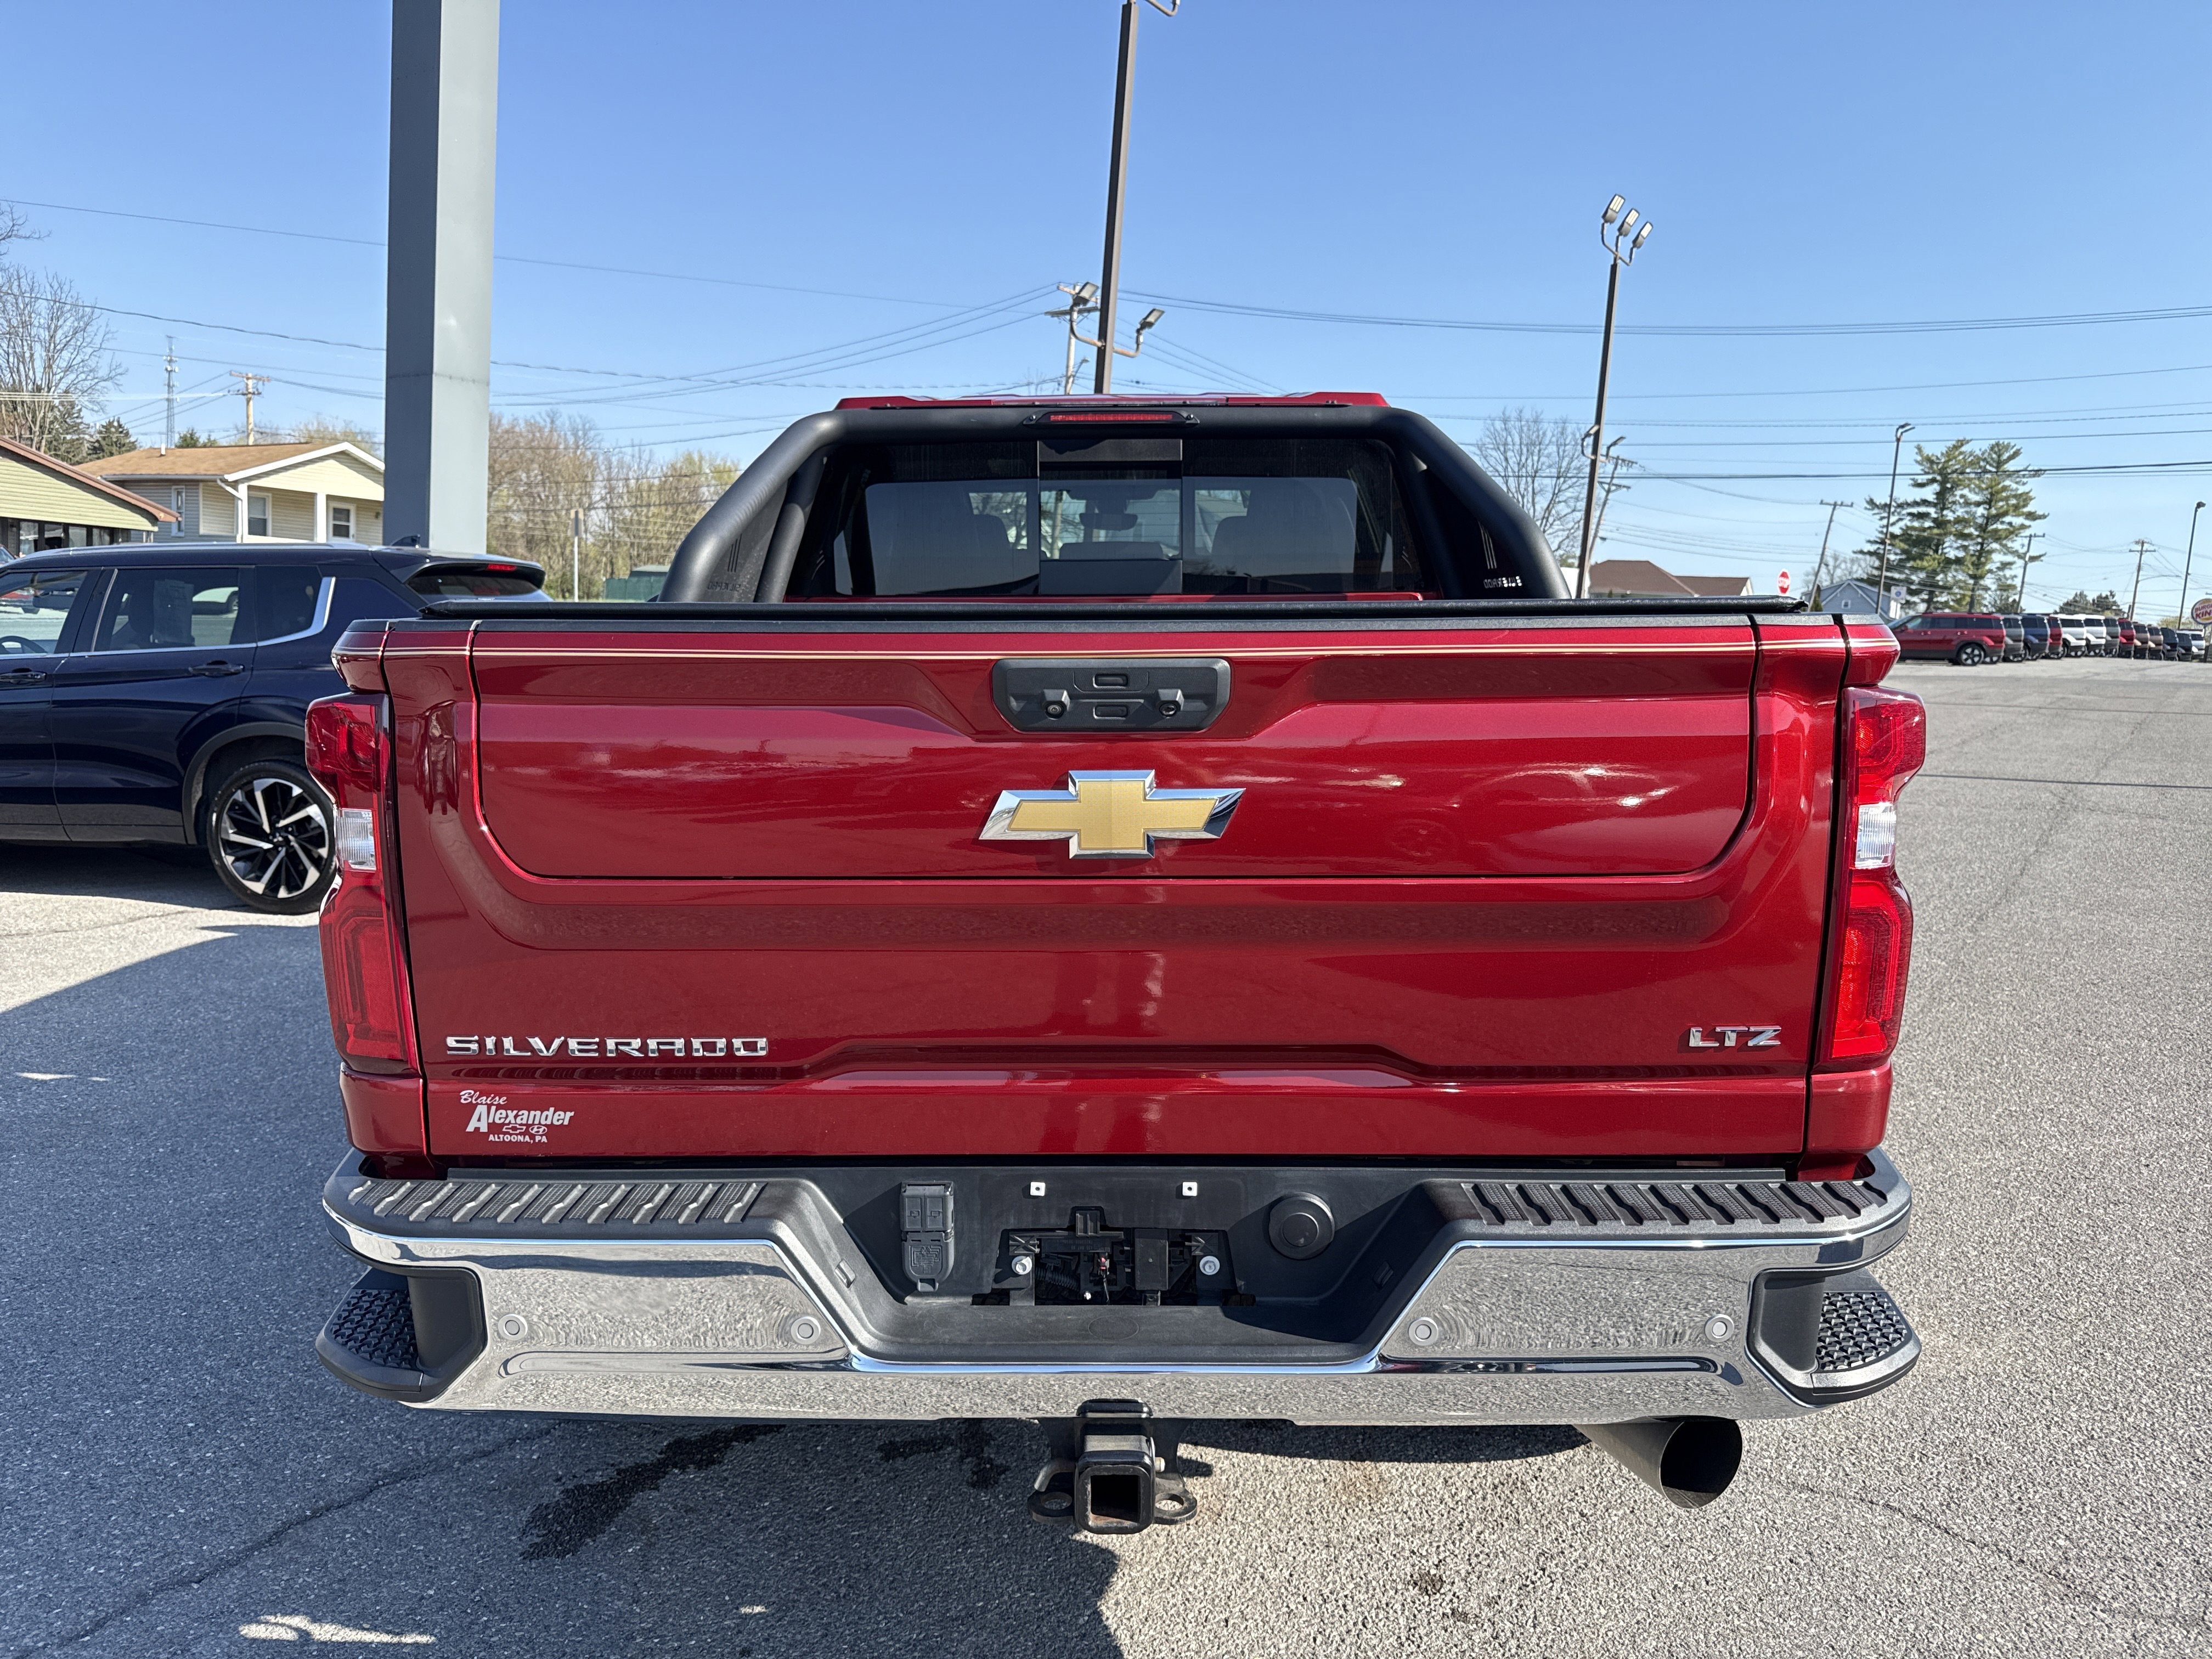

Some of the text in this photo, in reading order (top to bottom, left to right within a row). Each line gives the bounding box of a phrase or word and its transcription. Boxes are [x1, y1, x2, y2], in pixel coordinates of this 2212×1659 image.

[2195, 610, 2212, 619] KIN
[1689, 1026, 1782, 1047] LTZ
[446, 1035, 768, 1057] SILVERADO
[459, 1090, 507, 1104] Blaise
[465, 1104, 575, 1132] Alexander
[488, 1134, 533, 1144] ALTOONA,
